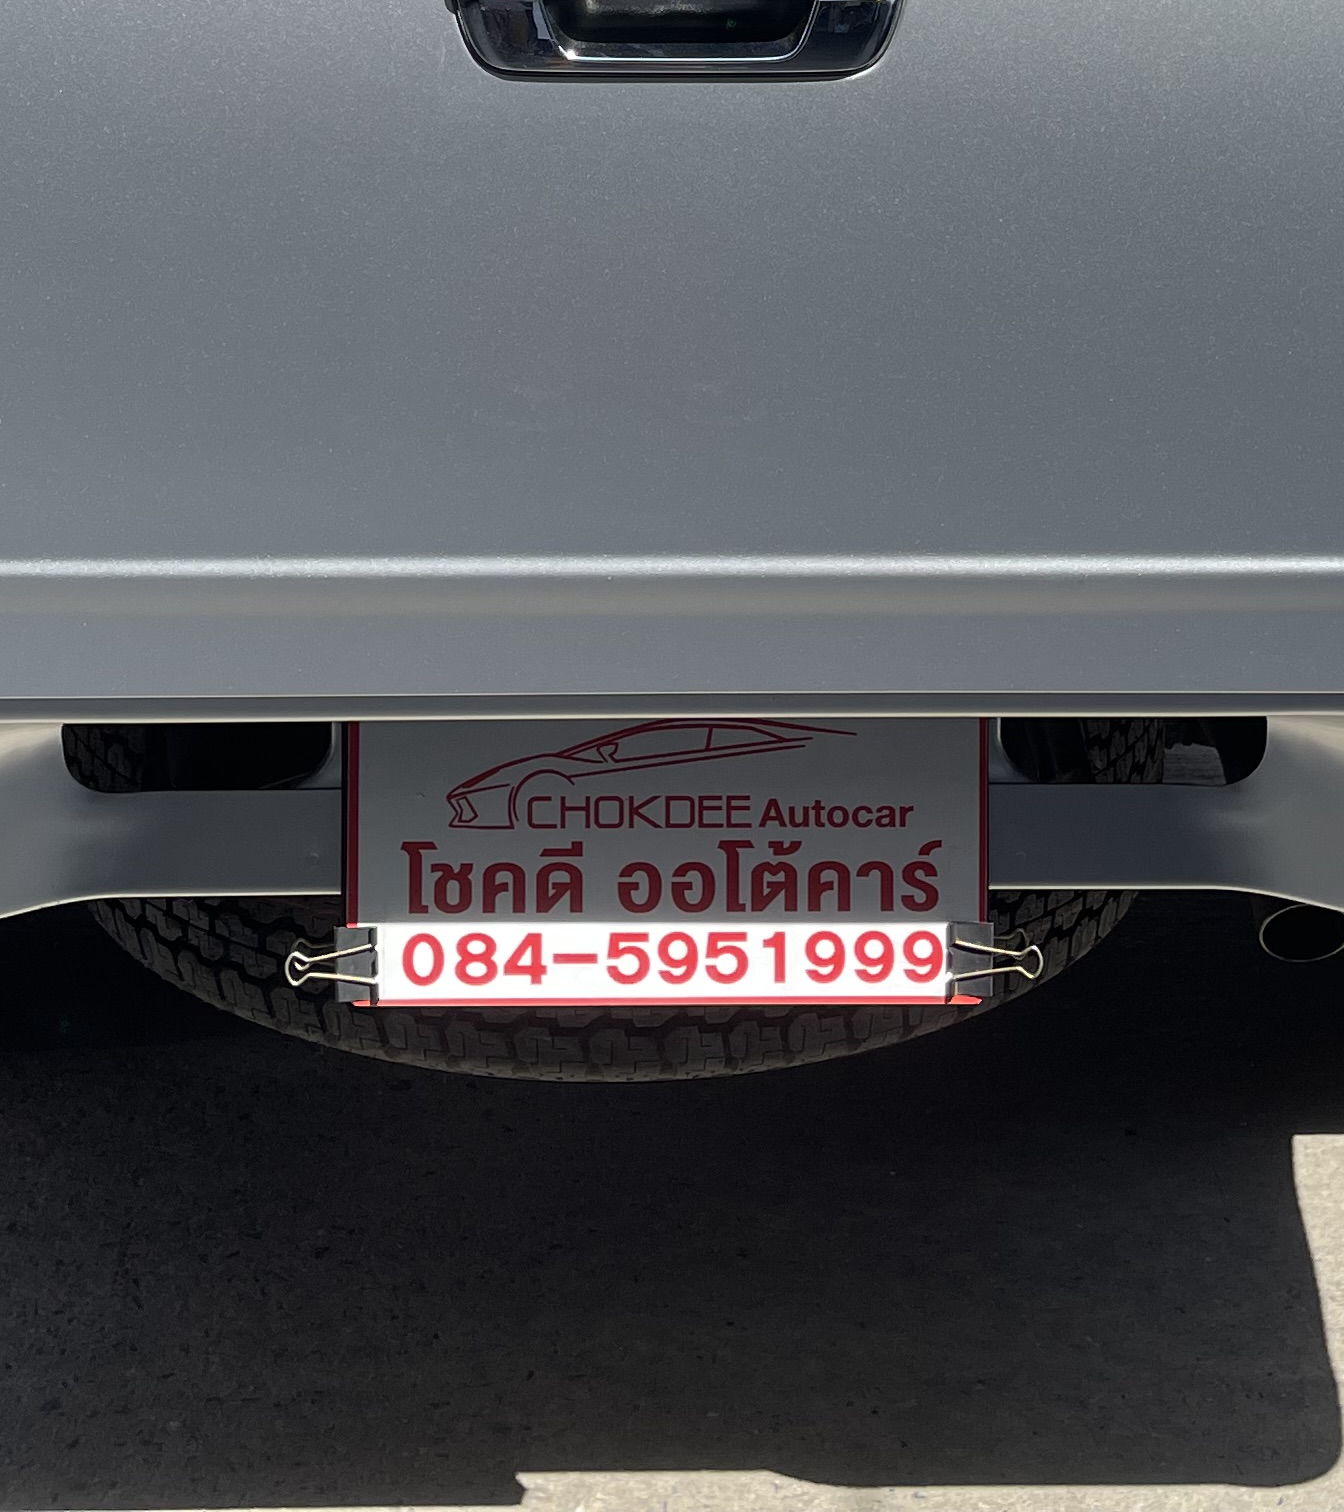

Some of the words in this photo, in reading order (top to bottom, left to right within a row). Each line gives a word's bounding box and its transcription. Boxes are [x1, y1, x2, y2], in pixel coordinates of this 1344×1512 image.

[527, 795, 753, 829] CHOKDEE
[759, 798, 915, 828] Autocar
[400, 840, 584, 915] โชคดี
[617, 839, 943, 914] ออโต้คาร์
[402, 929, 944, 986] 084-5951999
